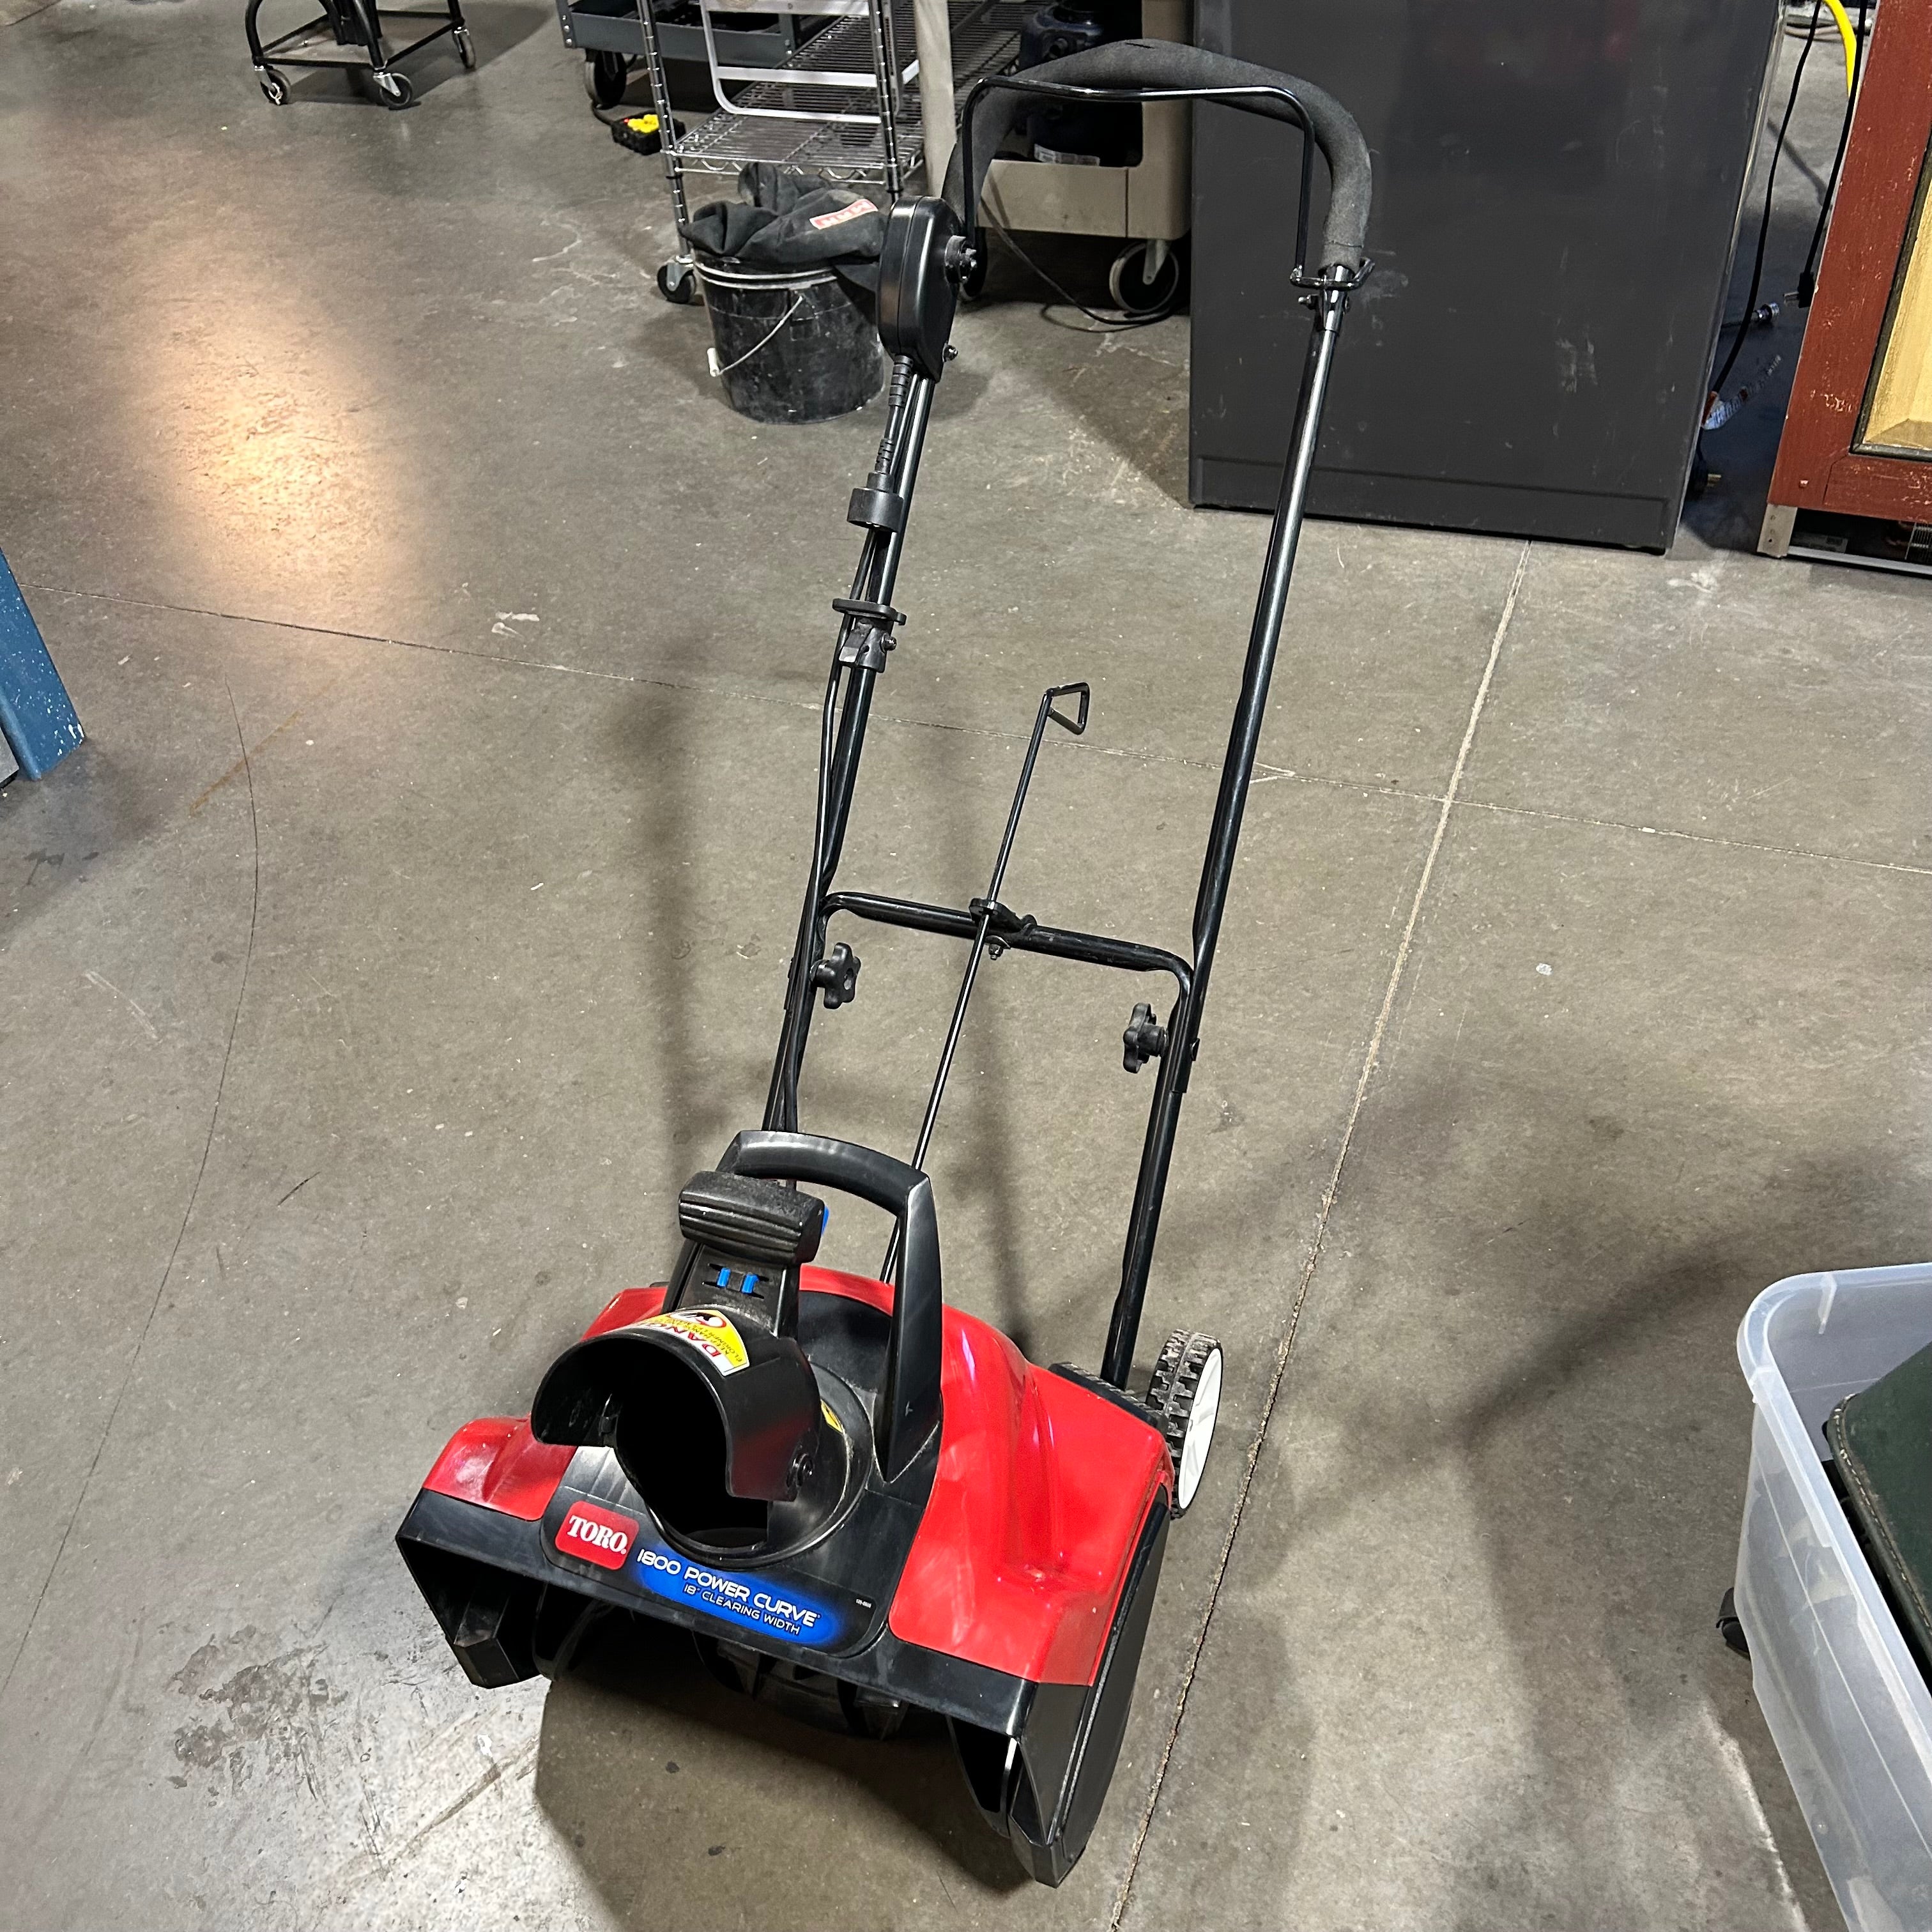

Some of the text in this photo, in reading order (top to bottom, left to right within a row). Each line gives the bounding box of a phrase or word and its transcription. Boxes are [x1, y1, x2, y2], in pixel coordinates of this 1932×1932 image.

[637, 1548, 682, 1575] 1800
[684, 1566, 751, 1602] POWER
[702, 1590, 761, 1620] CLEARING
[763, 1613, 801, 1635] WIDTH
